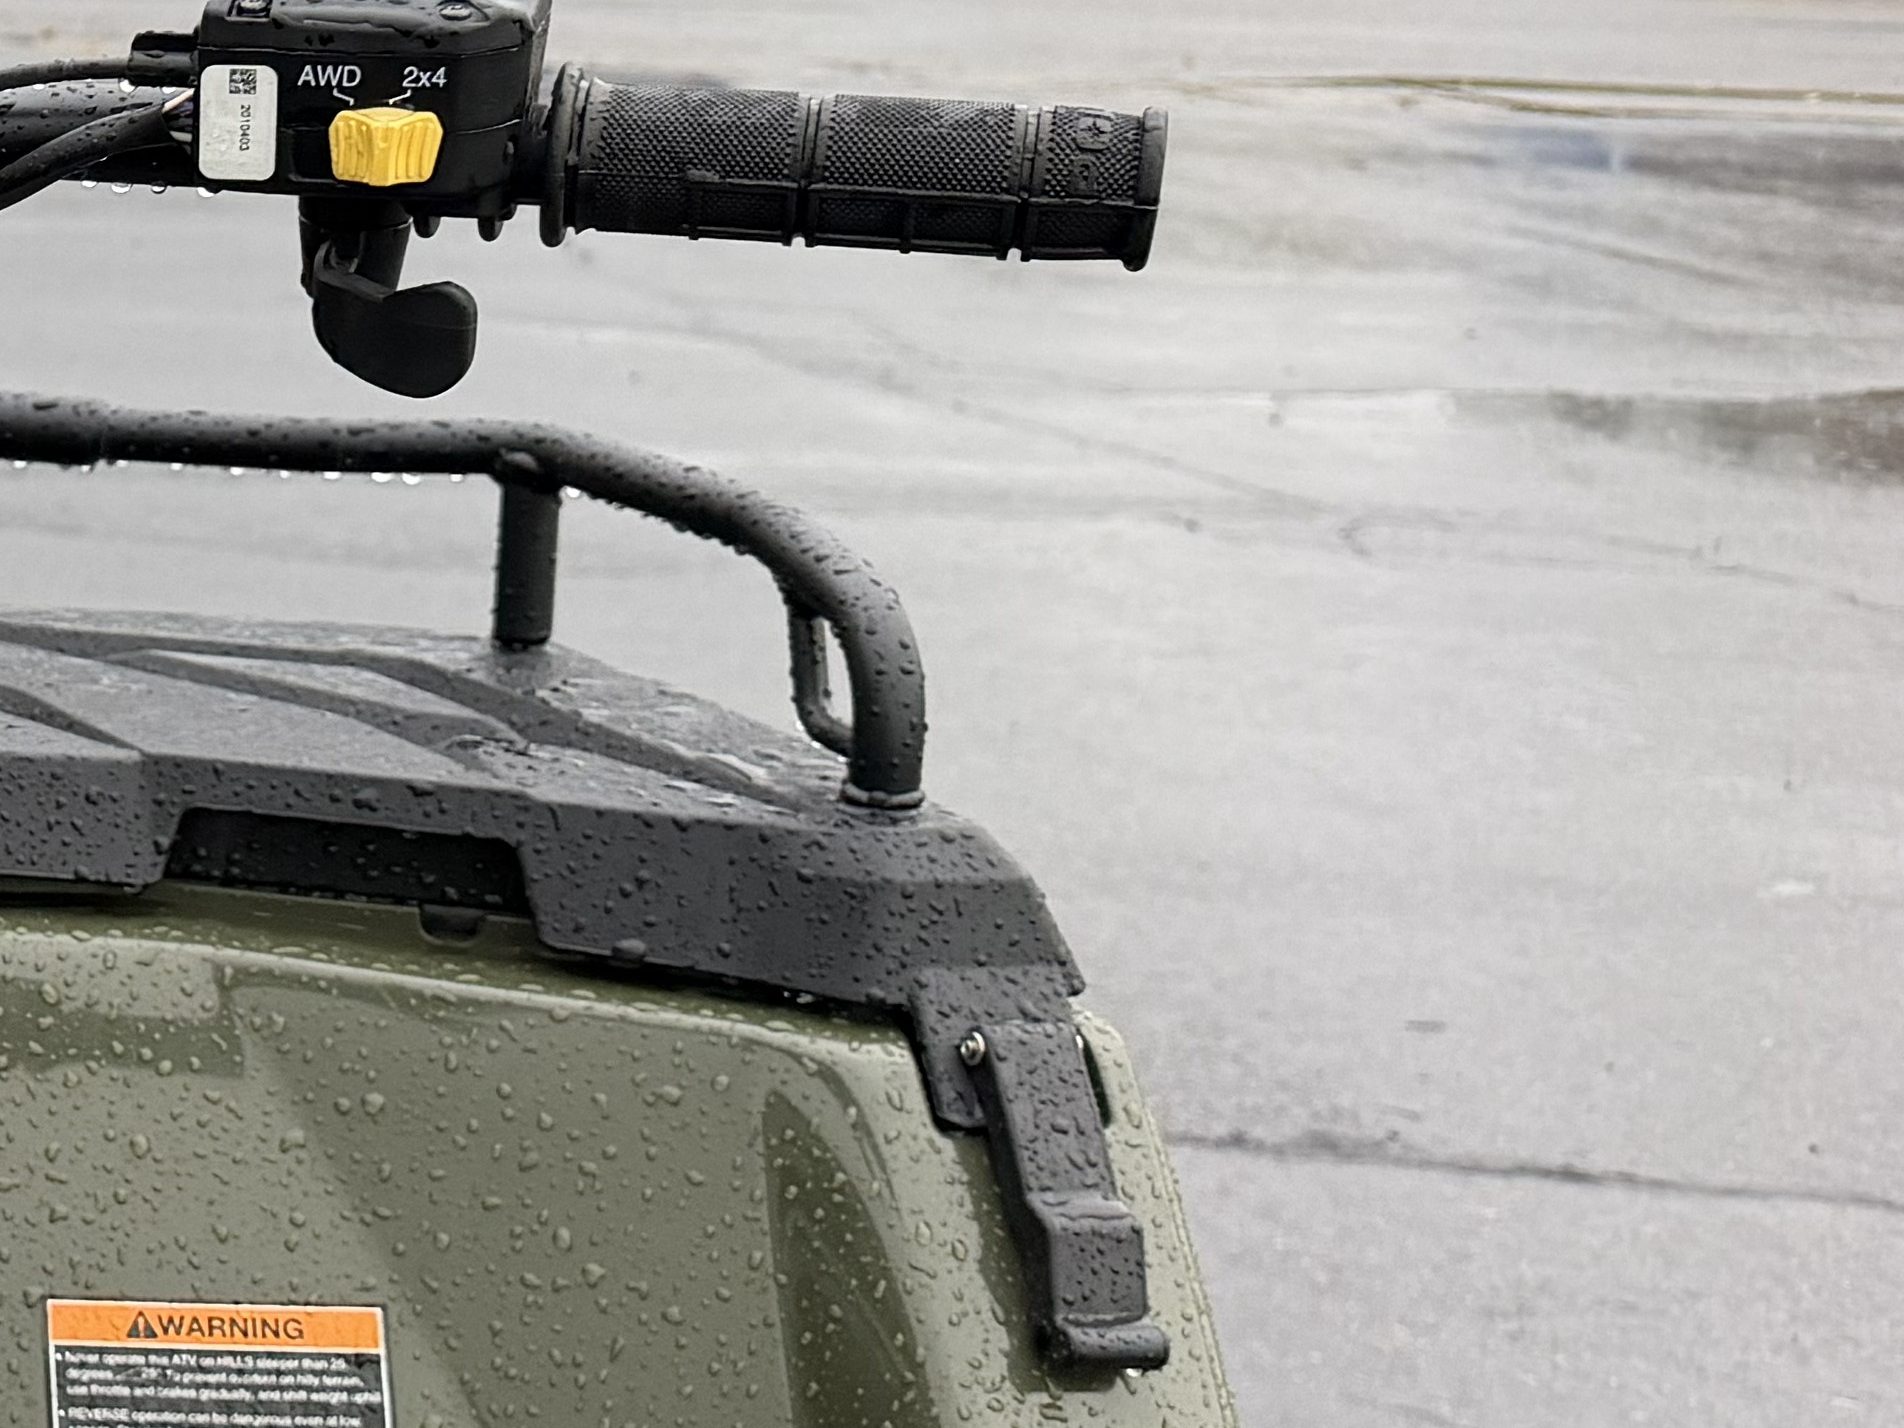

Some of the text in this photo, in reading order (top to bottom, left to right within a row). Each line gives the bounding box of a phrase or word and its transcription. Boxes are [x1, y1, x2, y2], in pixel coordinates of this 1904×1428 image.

[297, 64, 448, 88] AWD 2x4
[157, 1315, 304, 1339] WARNING
